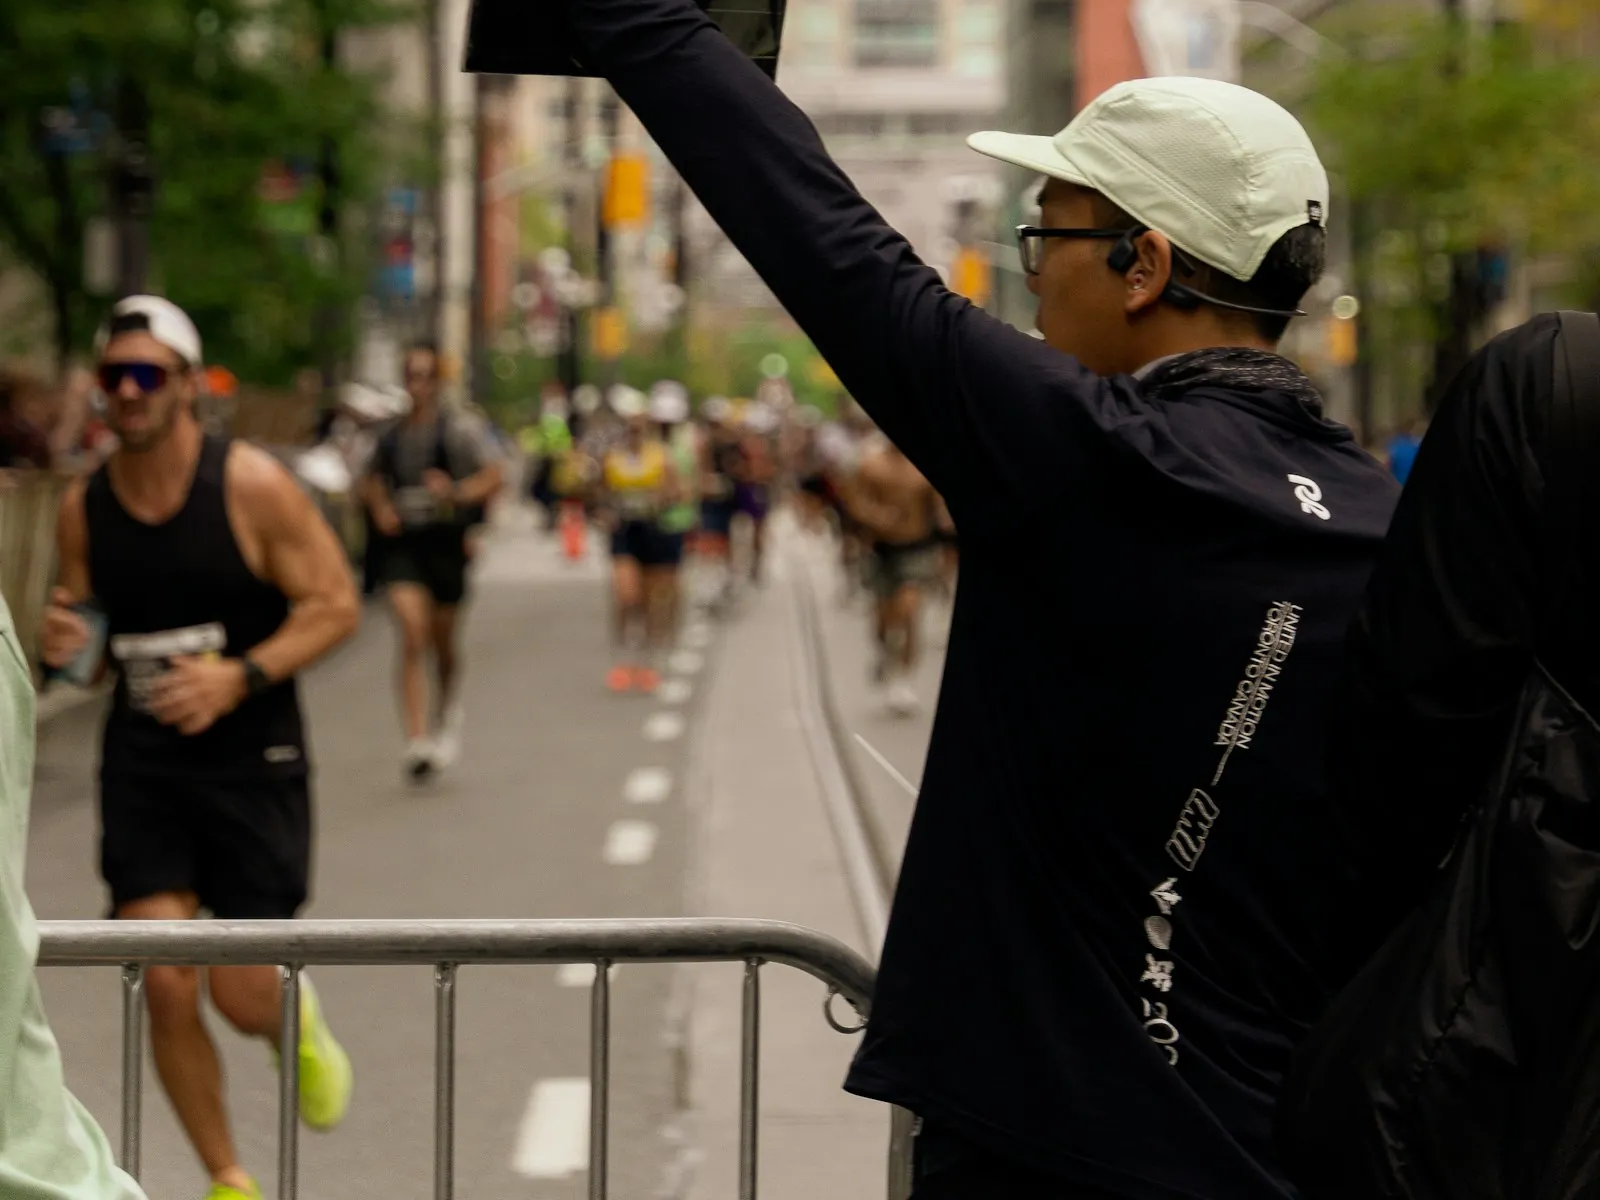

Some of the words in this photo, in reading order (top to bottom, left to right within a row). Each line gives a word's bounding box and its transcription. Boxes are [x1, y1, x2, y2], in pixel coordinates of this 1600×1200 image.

[1244, 601, 1287, 679] TORONTO
[1271, 603, 1304, 663] UNITED
[1264, 663, 1283, 683] IN
[1213, 680, 1254, 746] CANADA
[1236, 682, 1274, 750] MOTION
